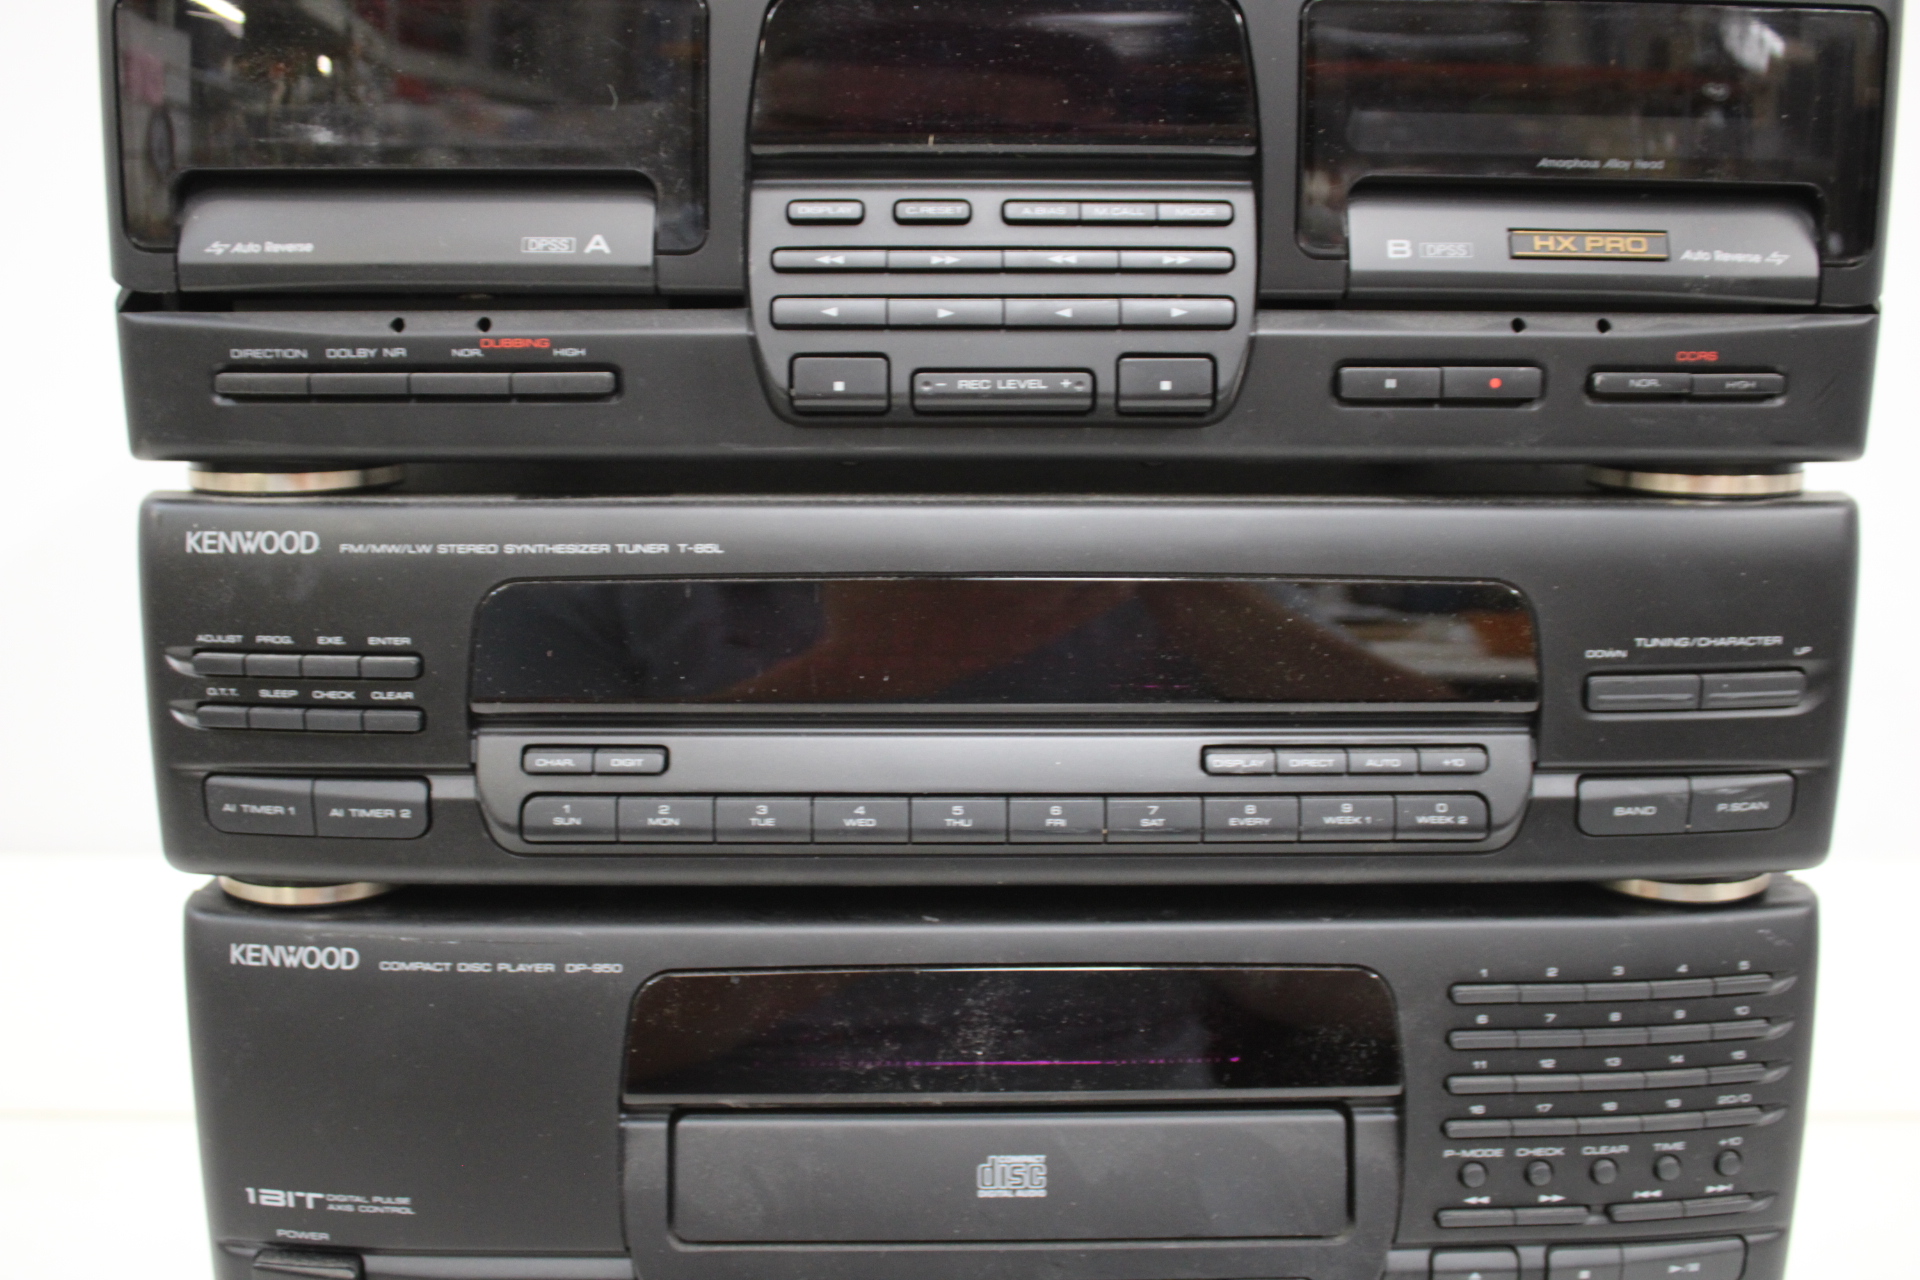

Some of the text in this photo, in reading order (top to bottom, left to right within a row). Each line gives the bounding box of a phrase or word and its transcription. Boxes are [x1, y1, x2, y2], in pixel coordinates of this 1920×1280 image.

[797, 205, 855, 214] DISPLAY
[905, 206, 964, 215] C.RESET
[1174, 206, 1216, 216] MODE
[229, 241, 314, 253] Auto Reverse
[528, 238, 569, 251] DPSS
[584, 234, 611, 254] A
[1387, 239, 1412, 258] B
[1532, 236, 1647, 254] HX PRO
[1425, 244, 1467, 256] DPSS
[1680, 250, 1762, 263] Auto Reverse
[480, 338, 550, 348] DUBBING
[230, 348, 308, 359] DIRECTION
[325, 347, 407, 359] DOLBY NR
[553, 348, 586, 357] HIGH
[957, 379, 991, 390] REC
[997, 379, 1048, 389] LEVEL
[1725, 380, 1757, 389] HIGH
[186, 530, 320, 554] KENWOOD
[339, 543, 433, 554] FM/MW/LW
[437, 544, 499, 554] STEREO
[503, 543, 611, 554] SYNTHESIZER
[615, 543, 669, 554] TUNER
[196, 634, 243, 643] ADJUST
[367, 637, 411, 646] ENTER
[1634, 636, 1783, 648] TUNING/CHARACTER
[1585, 649, 1628, 658] DOWN
[258, 689, 298, 698] SLEEP
[312, 690, 355, 700] CHECK
[370, 691, 414, 700] CLEAR
[610, 758, 645, 767] DIGIT
[1211, 757, 1266, 767] DISPLAY
[1288, 757, 1335, 767] DIRECT
[1365, 758, 1401, 767] AUTO
[1442, 758, 1465, 767] +10
[241, 804, 285, 815] TIMER
[288, 806, 295, 815] 1
[563, 804, 570, 813] 1
[658, 805, 670, 815] 2
[756, 805, 768, 815] 3
[854, 806, 866, 815] 4
[952, 805, 964, 815] 5
[1050, 805, 1062, 815] 6
[1147, 805, 1159, 815] 7
[1245, 804, 1256, 815] 8
[1341, 803, 1353, 813] 9
[1436, 803, 1448, 813] 0
[1613, 806, 1657, 816] BAND
[1716, 802, 1769, 812] P.SCAN
[348, 808, 395, 818] TIMER
[399, 809, 411, 818] 2
[552, 816, 582, 825] SUN
[647, 817, 680, 826] MON
[749, 817, 776, 826] TUE
[843, 818, 876, 827] WED
[944, 818, 972, 827] THU
[1045, 818, 1067, 827] FRI
[1140, 818, 1166, 827] SAT
[1228, 817, 1272, 826] EVERY
[1323, 816, 1372, 825] WEEK 1
[1415, 815, 1468, 824] WEEK 2
[230, 943, 360, 970] KENWOOD
[379, 961, 452, 972] COMPACT
[457, 962, 492, 972] DISC
[497, 963, 555, 973] PLAYER
[1677, 964, 1688, 972] 4
[1739, 960, 1750, 970] 5
[1480, 969, 1488, 977] 1
[1546, 967, 1558, 977] 2
[1613, 966, 1624, 976] 3
[1675, 1009, 1686, 1019] 9
[1734, 1006, 1750, 1015] 10
[1476, 1014, 1488, 1024] 6
[1545, 1013, 1557, 1022] 7
[1609, 1012, 1621, 1022] 8
[1539, 1059, 1556, 1068] 12
[1605, 1057, 1621, 1067] 13
[1669, 1055, 1684, 1063] 14
[1472, 1060, 1487, 1069] 11
[1536, 1103, 1553, 1112] 17
[1653, 1141, 1685, 1151] TIME
[1718, 1136, 1743, 1146] +10
[1443, 1148, 1504, 1158] P-MODE
[1515, 1147, 1565, 1157] CHECK
[1582, 1145, 1629, 1155] CLEAR
[325, 1194, 411, 1205] DIGITAL PULSE
[326, 1204, 415, 1215] AXIS CONTROL
[276, 1229, 330, 1241] POWER
